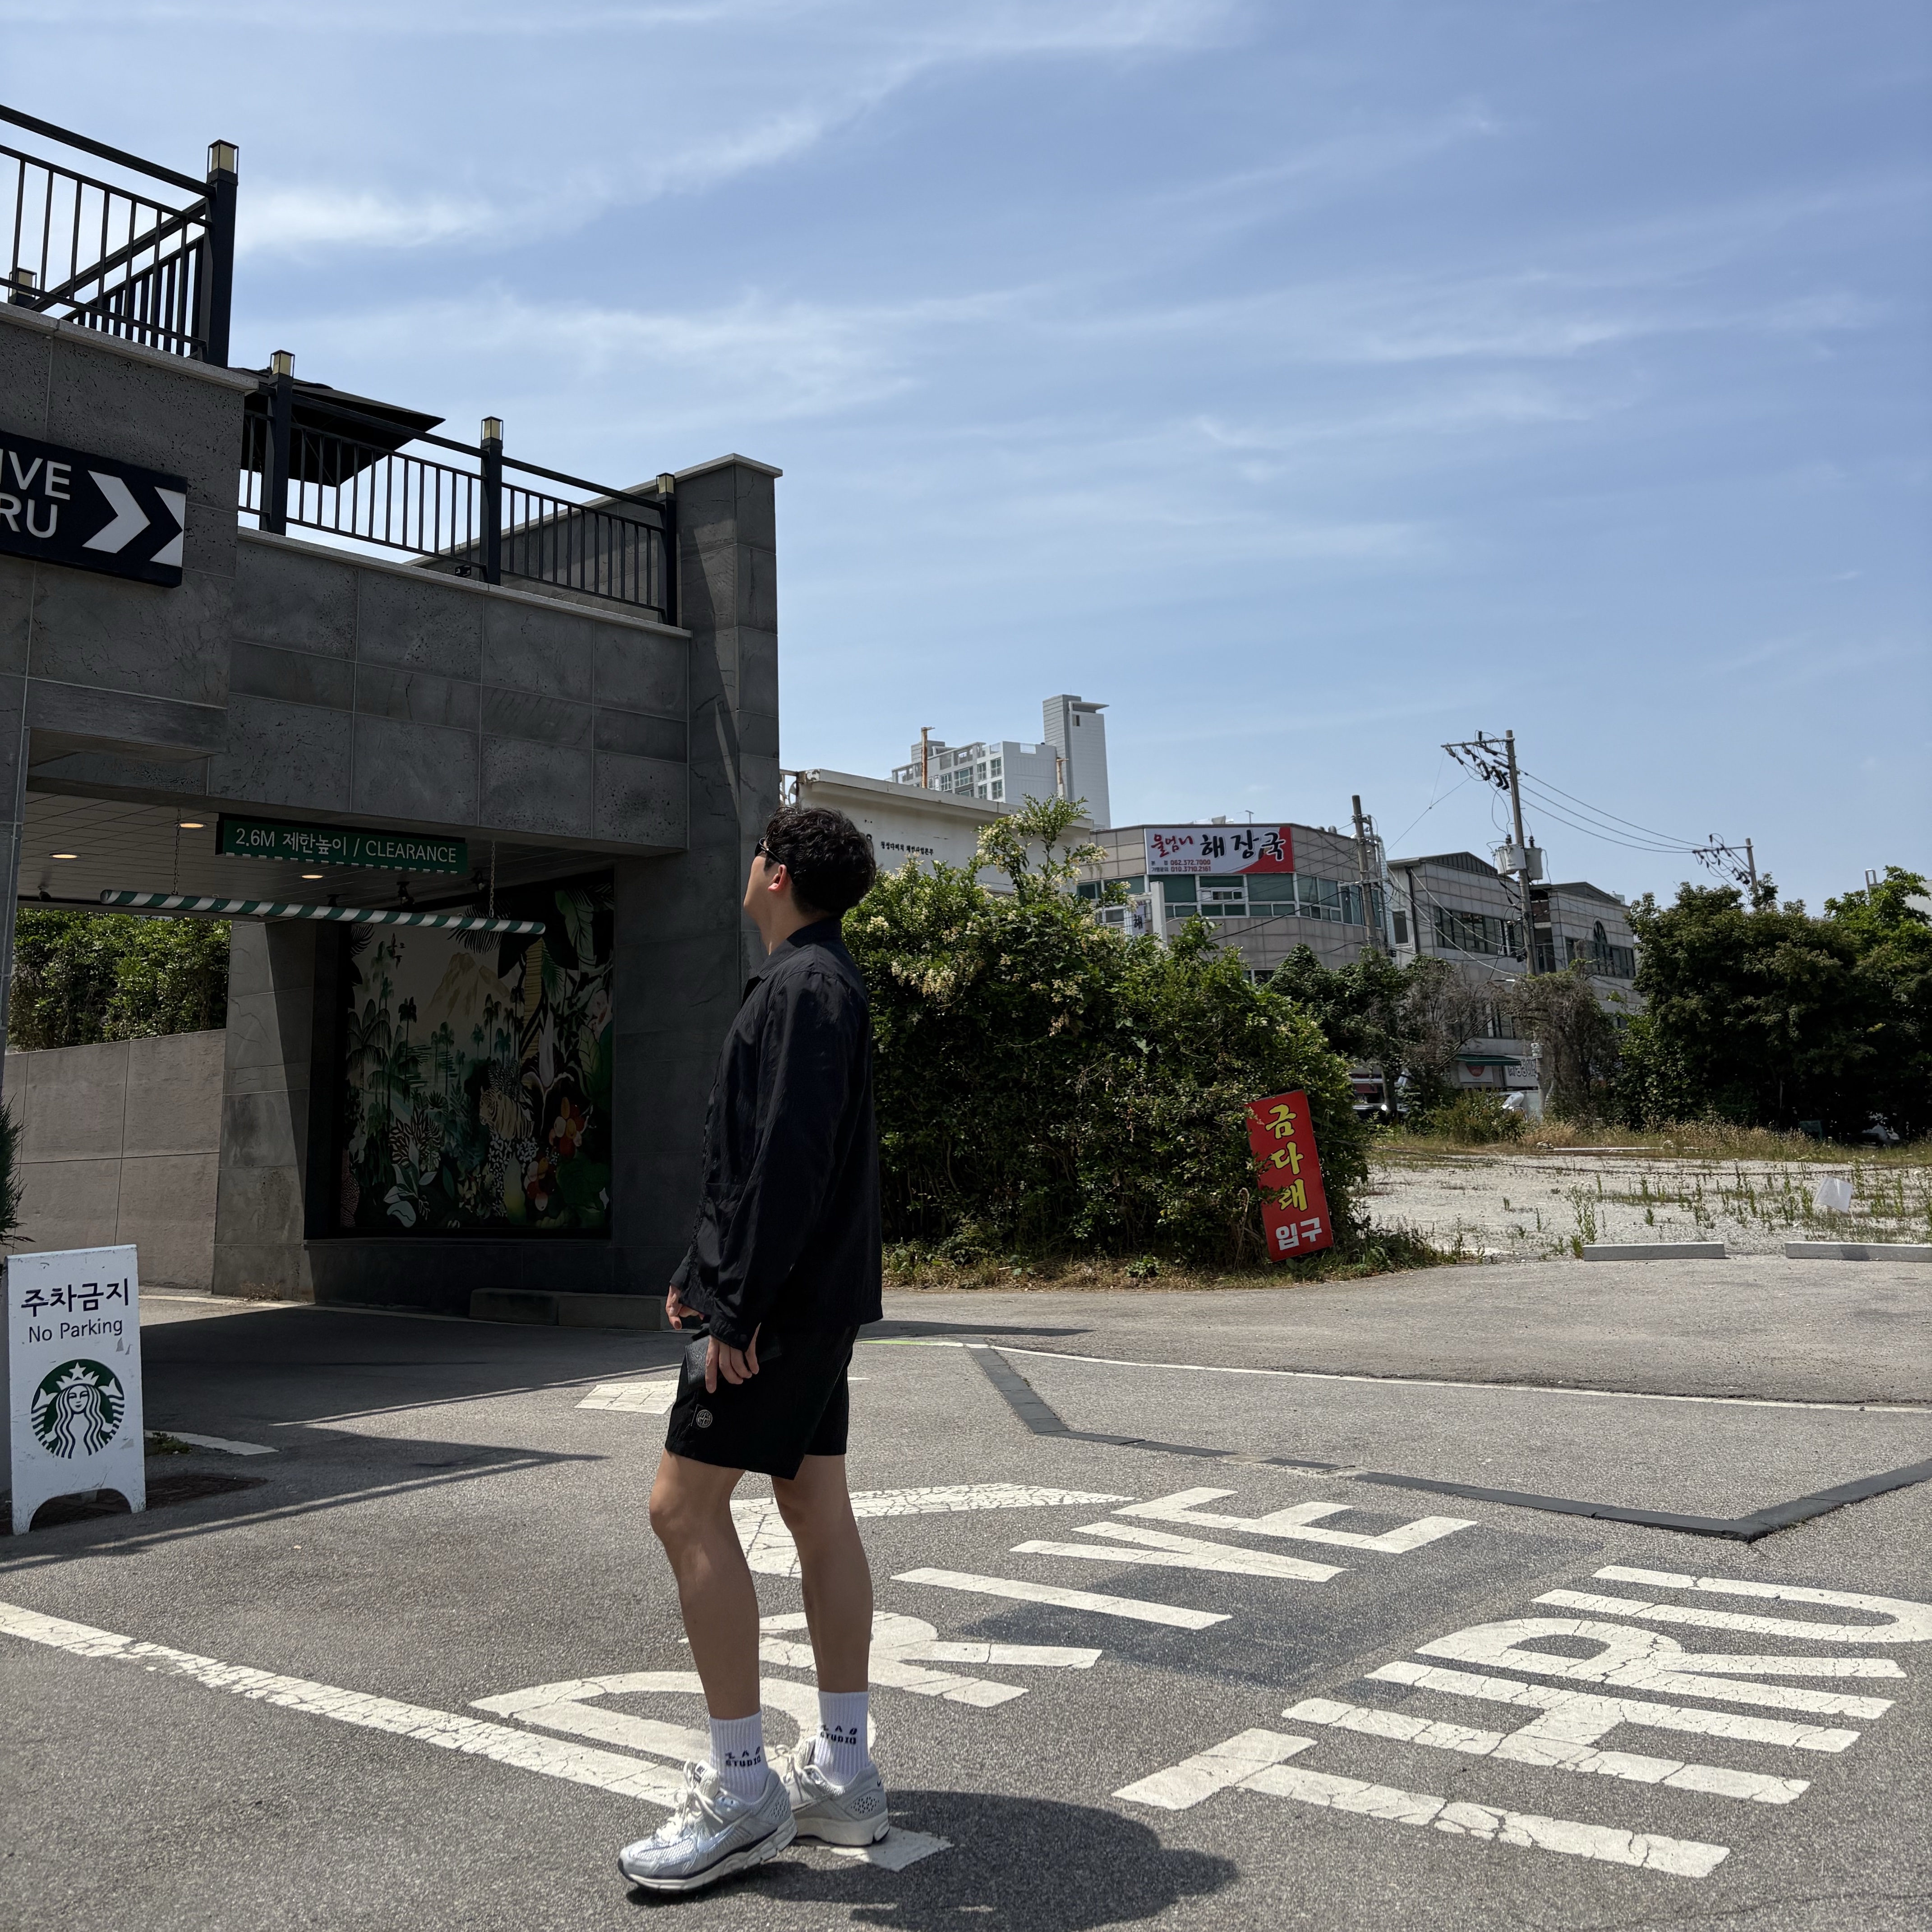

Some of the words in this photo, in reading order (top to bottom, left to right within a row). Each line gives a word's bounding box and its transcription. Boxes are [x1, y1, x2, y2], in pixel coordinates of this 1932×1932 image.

[236, 828, 275, 847] 2.6M
[283, 832, 346, 856] 제한높이
[353, 838, 360, 857] /
[365, 840, 456, 863] CLEARANCE
[1199, 829, 1286, 860] 해장국
[1265, 1104, 1308, 1211] 금다래
[1276, 1217, 1322, 1251] 입구
[21, 1278, 129, 1317] 주차금지
[29, 1326, 52, 1343] No
[60, 1318, 123, 1339] Parking
[1112, 1564, 1932, 1878] THRU
